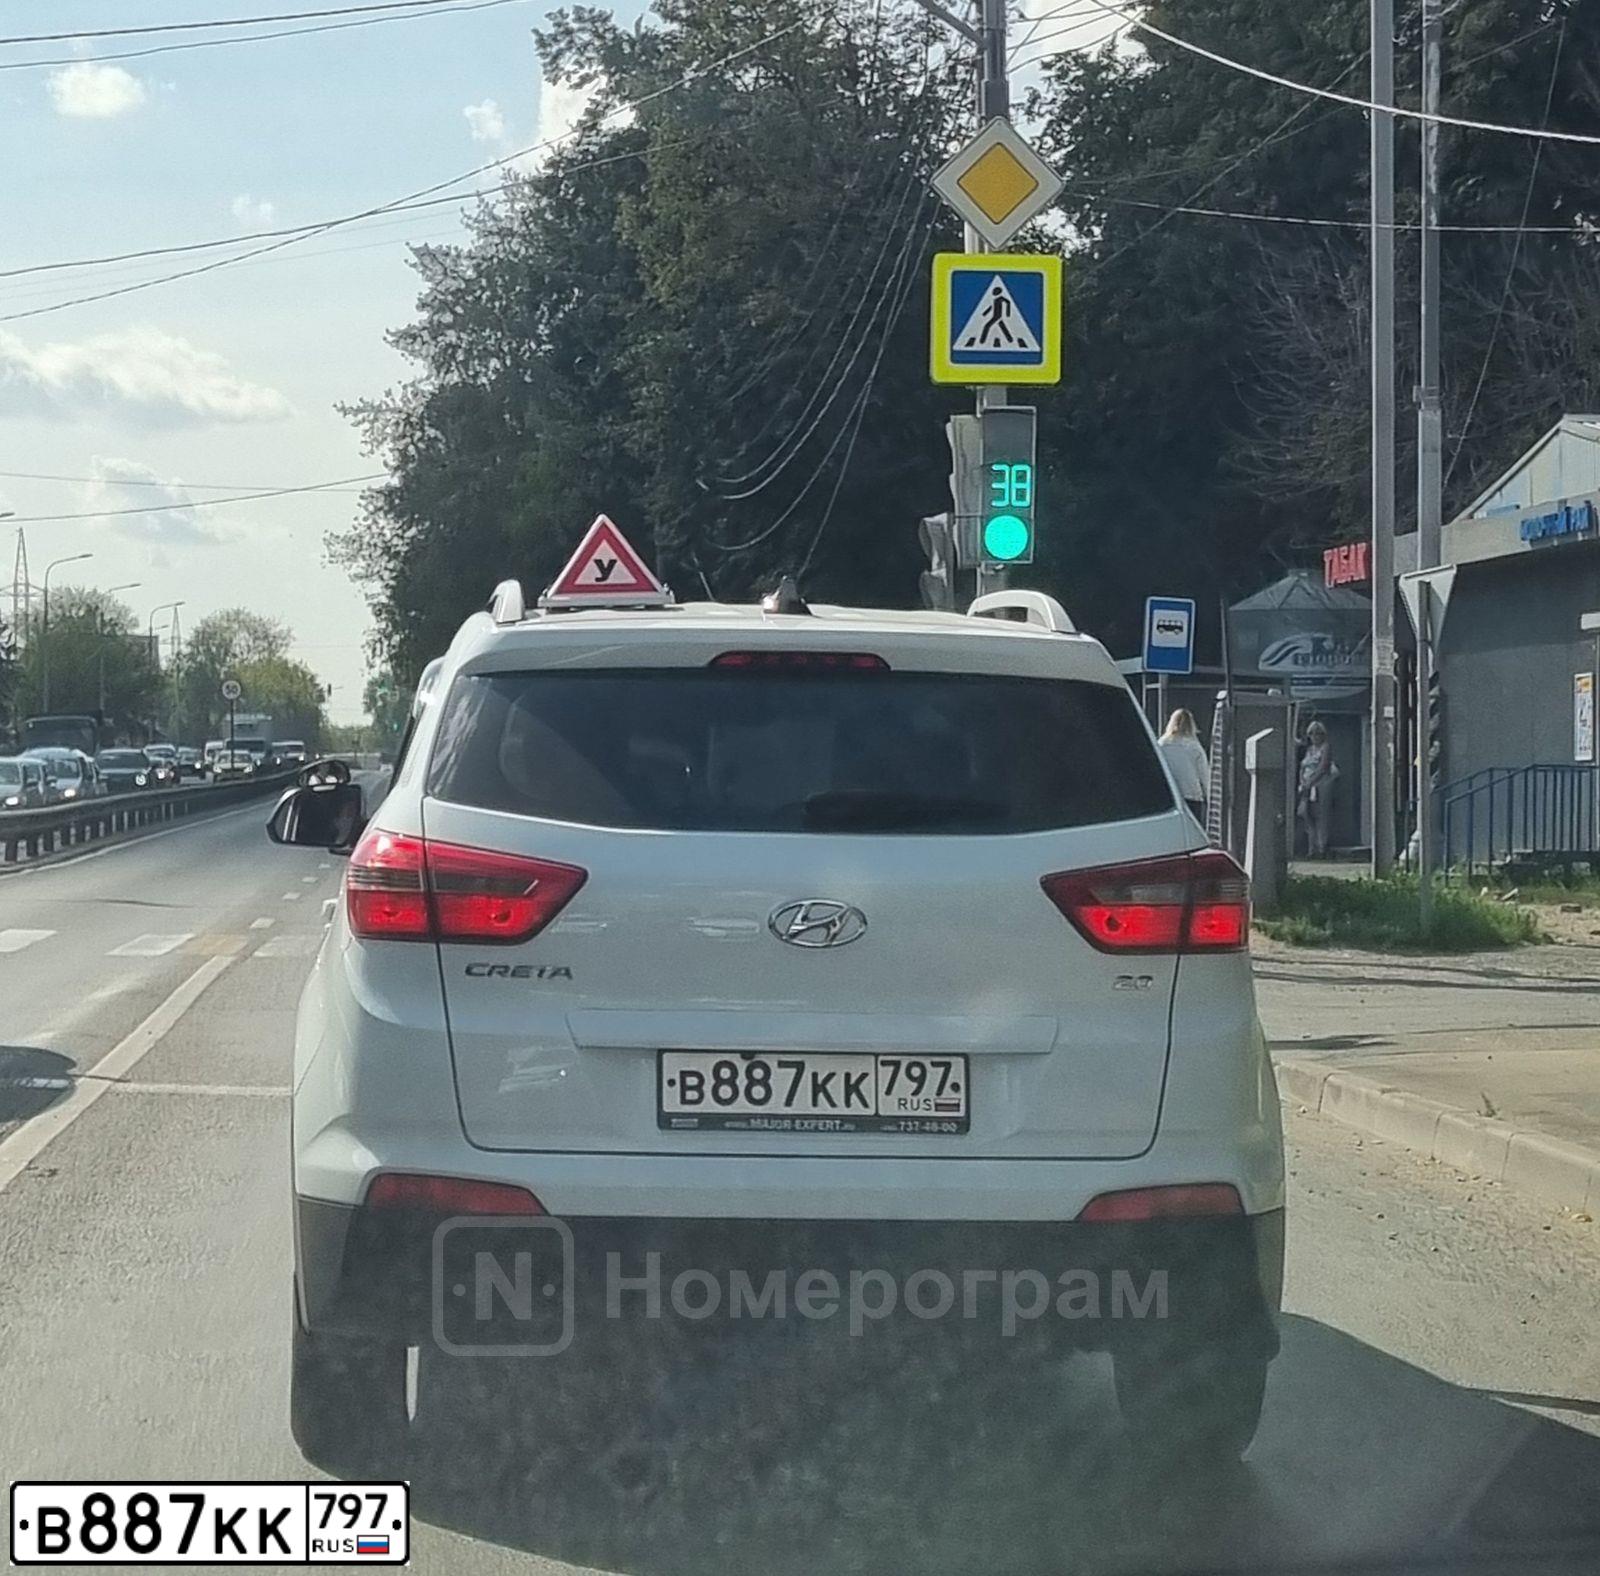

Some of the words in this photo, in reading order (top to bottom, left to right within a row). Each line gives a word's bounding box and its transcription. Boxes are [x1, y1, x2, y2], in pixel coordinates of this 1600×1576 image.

[991, 464, 1031, 507] 38
[593, 559, 618, 583] У
[1323, 542, 1367, 588] ТАБАК
[465, 962, 573, 980] CRETA
[679, 1059, 870, 1109] В887КК
[880, 1060, 952, 1097] 797
[898, 1098, 932, 1111] RUS
